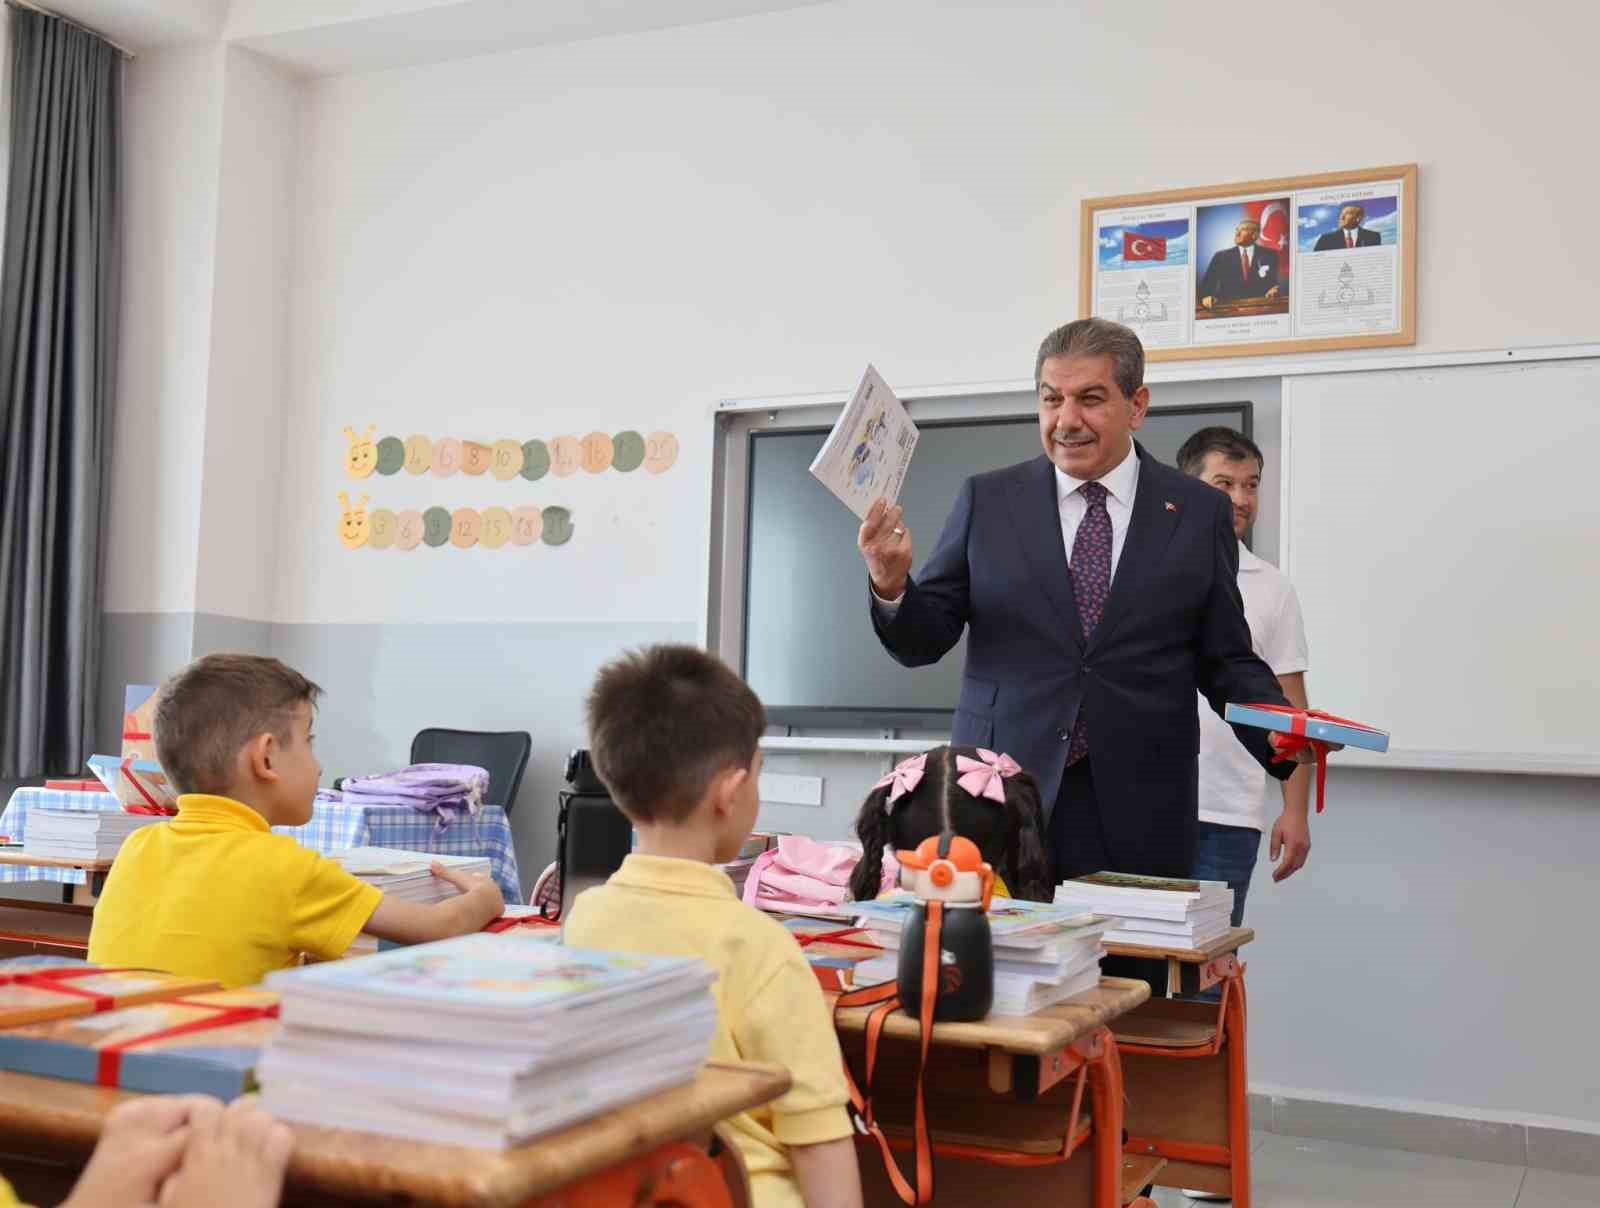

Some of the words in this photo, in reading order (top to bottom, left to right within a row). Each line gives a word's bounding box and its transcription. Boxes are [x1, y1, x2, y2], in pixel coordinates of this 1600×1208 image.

[469, 446, 480, 466] 8
[495, 447, 512, 466] 10
[400, 519, 410, 538] 6
[457, 521, 472, 537] 12
[486, 518, 501, 535] 15
[515, 517, 533, 537] 18
